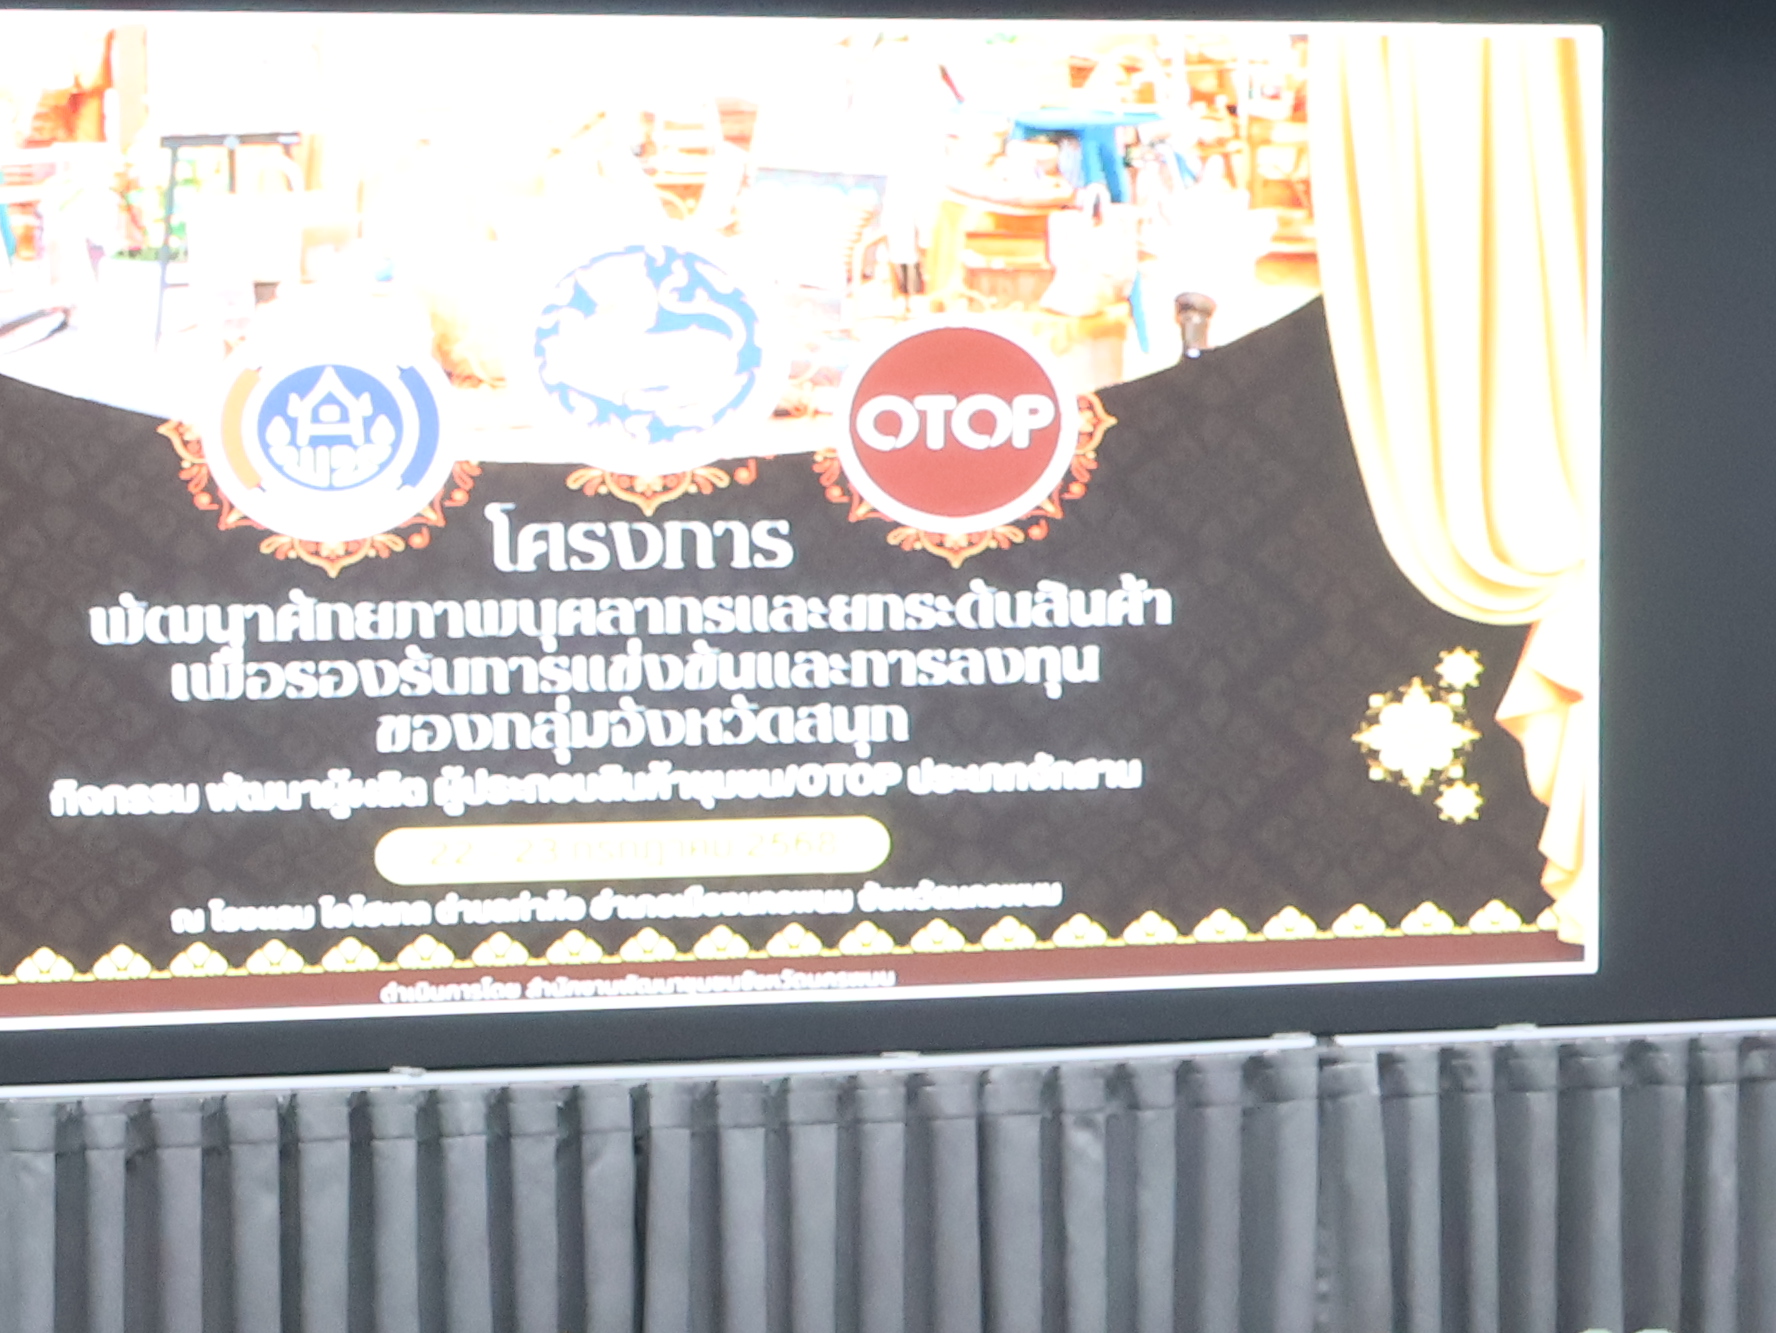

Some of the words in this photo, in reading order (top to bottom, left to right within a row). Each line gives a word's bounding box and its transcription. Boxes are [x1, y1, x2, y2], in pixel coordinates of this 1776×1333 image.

[853, 392, 1056, 451] OTOP
[484, 502, 794, 573] โครงการ
[89, 573, 1172, 652] พัฒนาศักยภาพบุคลากรและยกระดับสินค้า
[171, 636, 1100, 701] เพื่อรองรับการแข่งขันและการลงทุน
[376, 694, 909, 765] ของกลุ่มจังหวัดสนุก
[514, 838, 560, 865] 23
[746, 831, 838, 858] 2568
